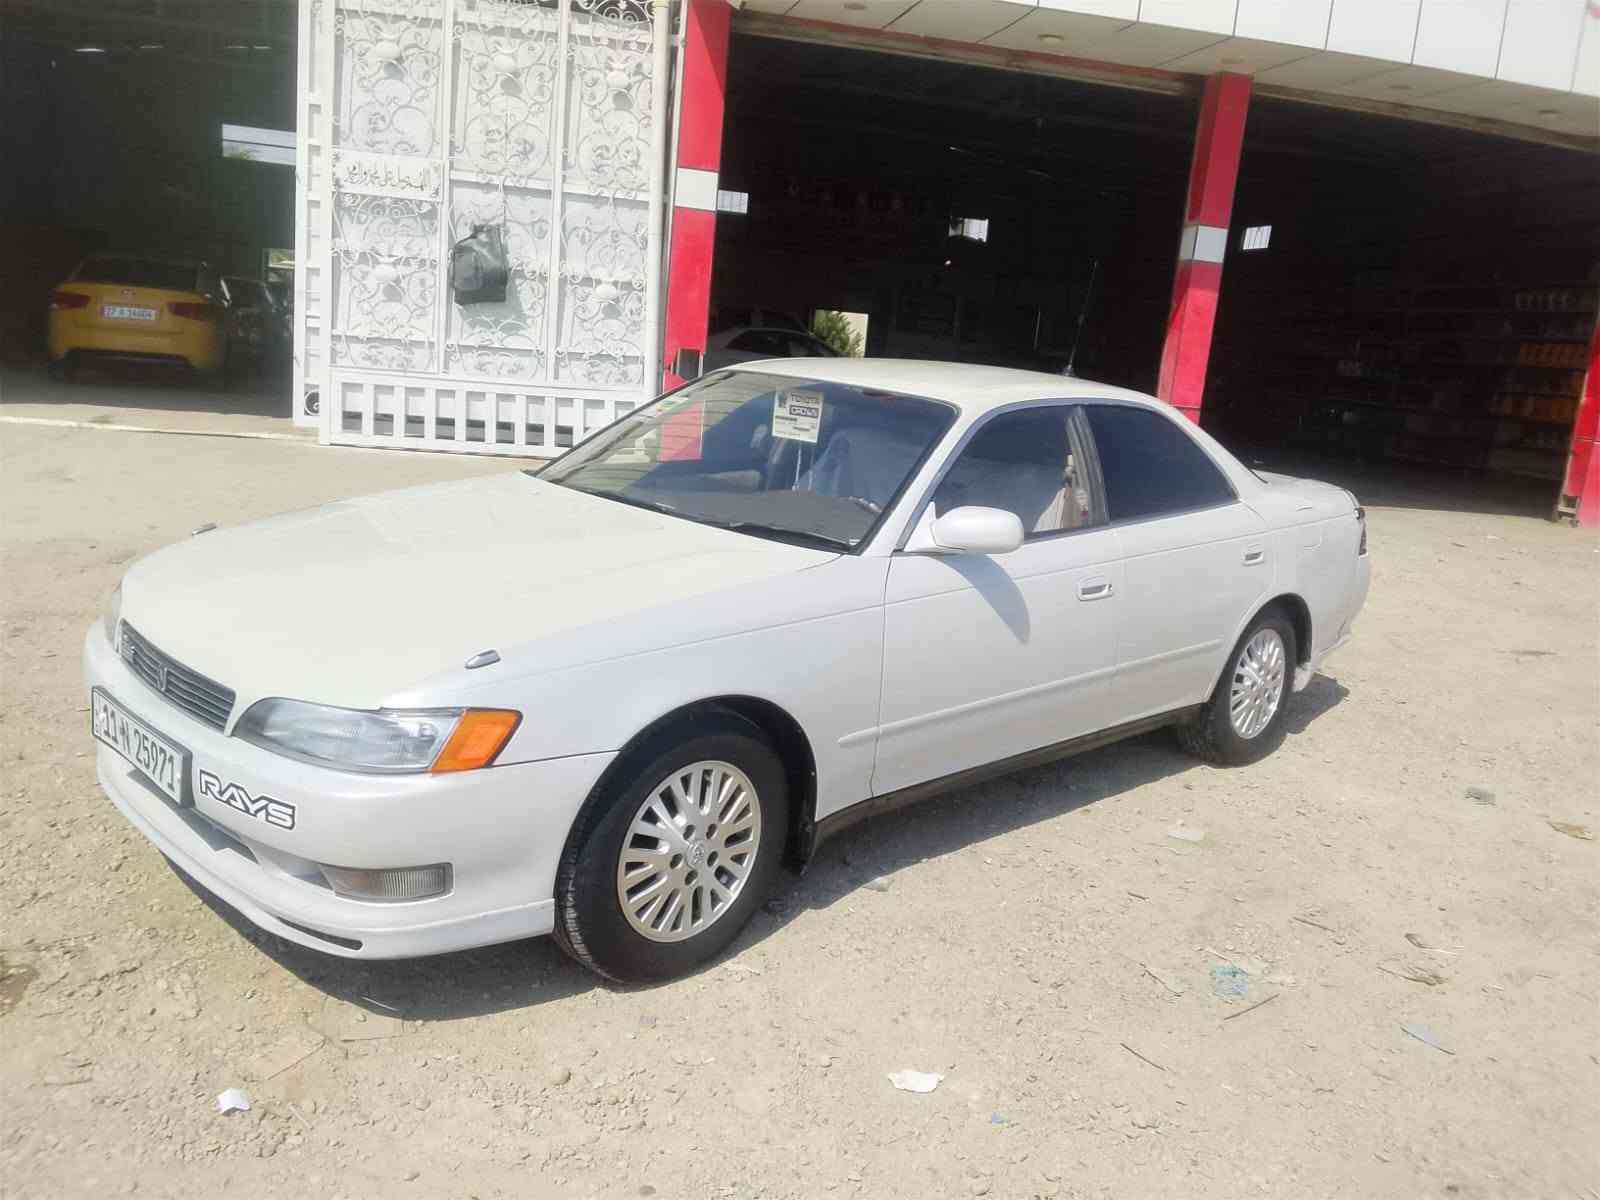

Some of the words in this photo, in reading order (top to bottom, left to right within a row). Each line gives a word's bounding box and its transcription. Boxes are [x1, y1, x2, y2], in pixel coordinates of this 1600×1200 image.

[103, 704, 119, 745] 11
[134, 728, 176, 793] 25971
[199, 769, 296, 831] RAYS
